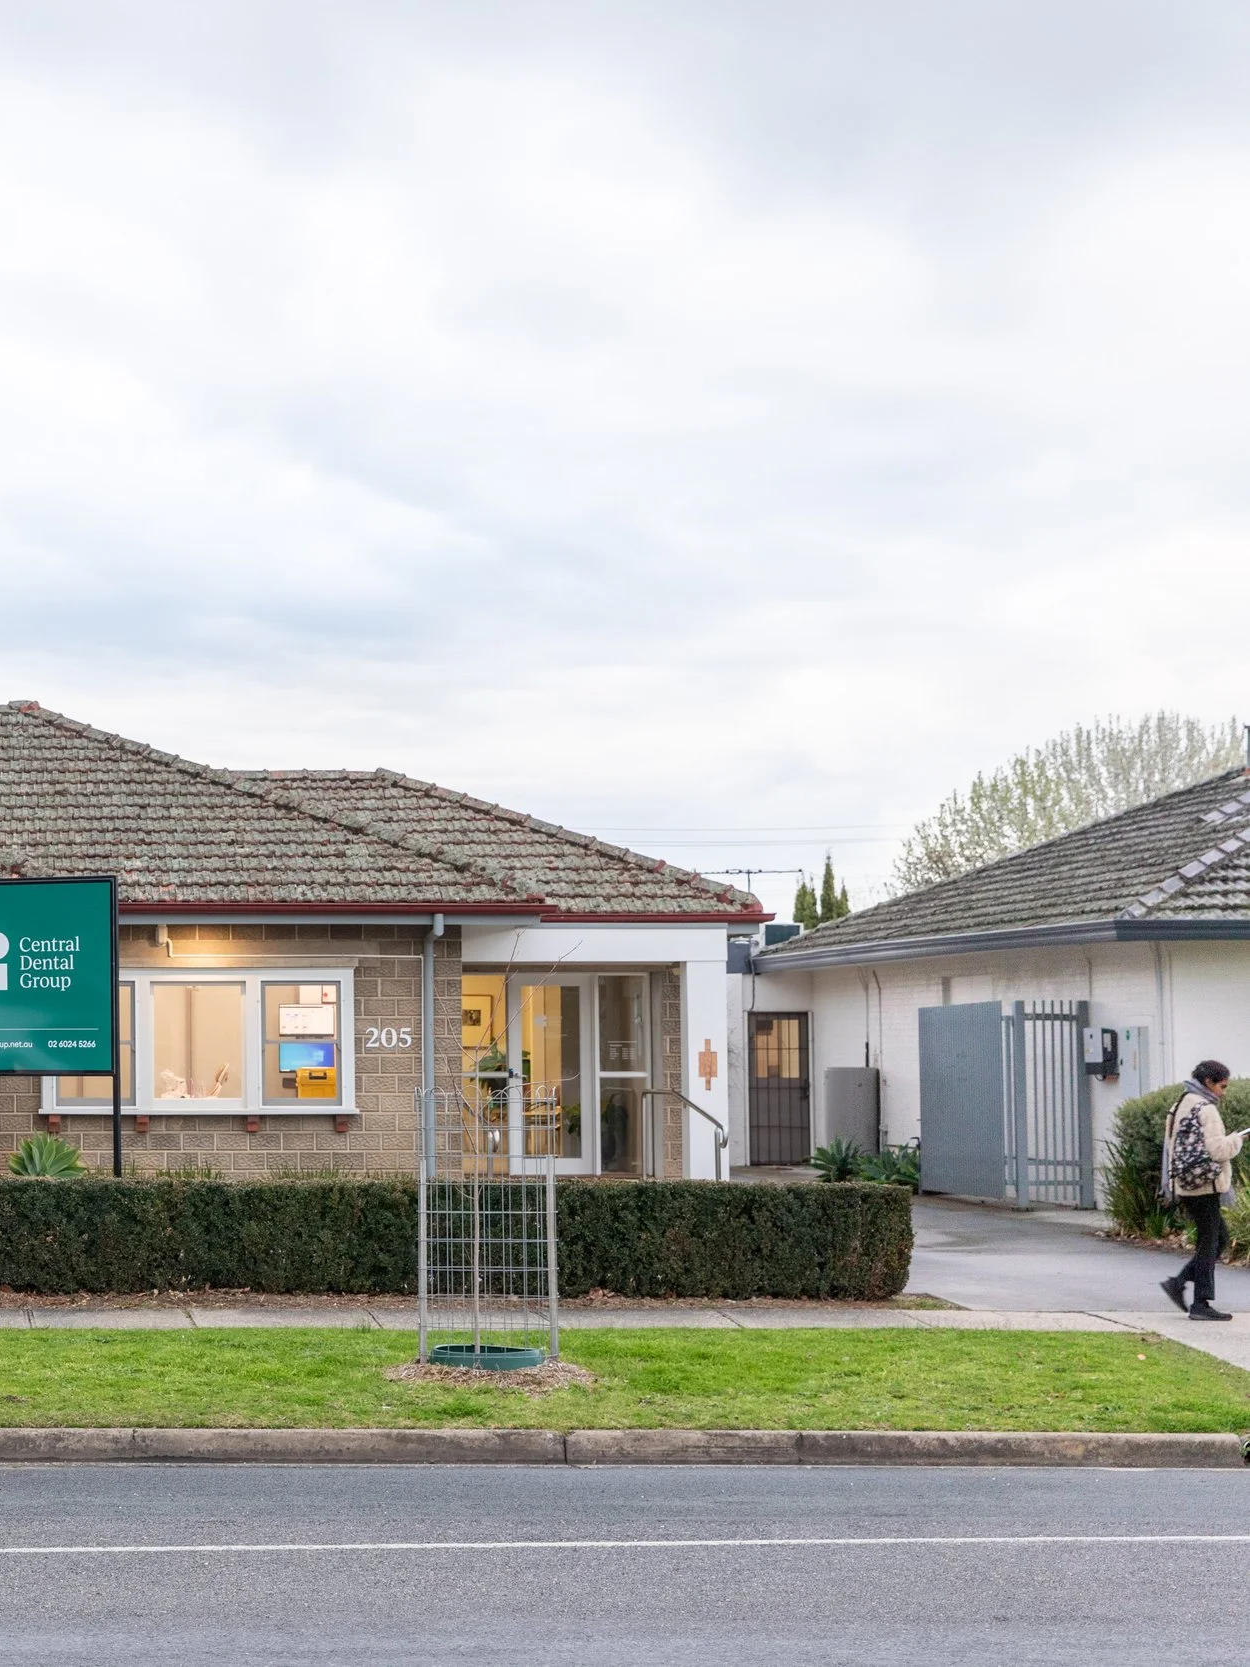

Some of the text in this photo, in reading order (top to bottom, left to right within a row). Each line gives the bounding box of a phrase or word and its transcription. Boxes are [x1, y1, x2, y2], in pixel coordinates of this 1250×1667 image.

[19, 936, 80, 952] Central
[19, 954, 75, 971] Dental
[19, 973, 72, 991] Group
[47, 1040, 96, 1048] 02 6024 5266
[365, 1027, 412, 1048] 205
